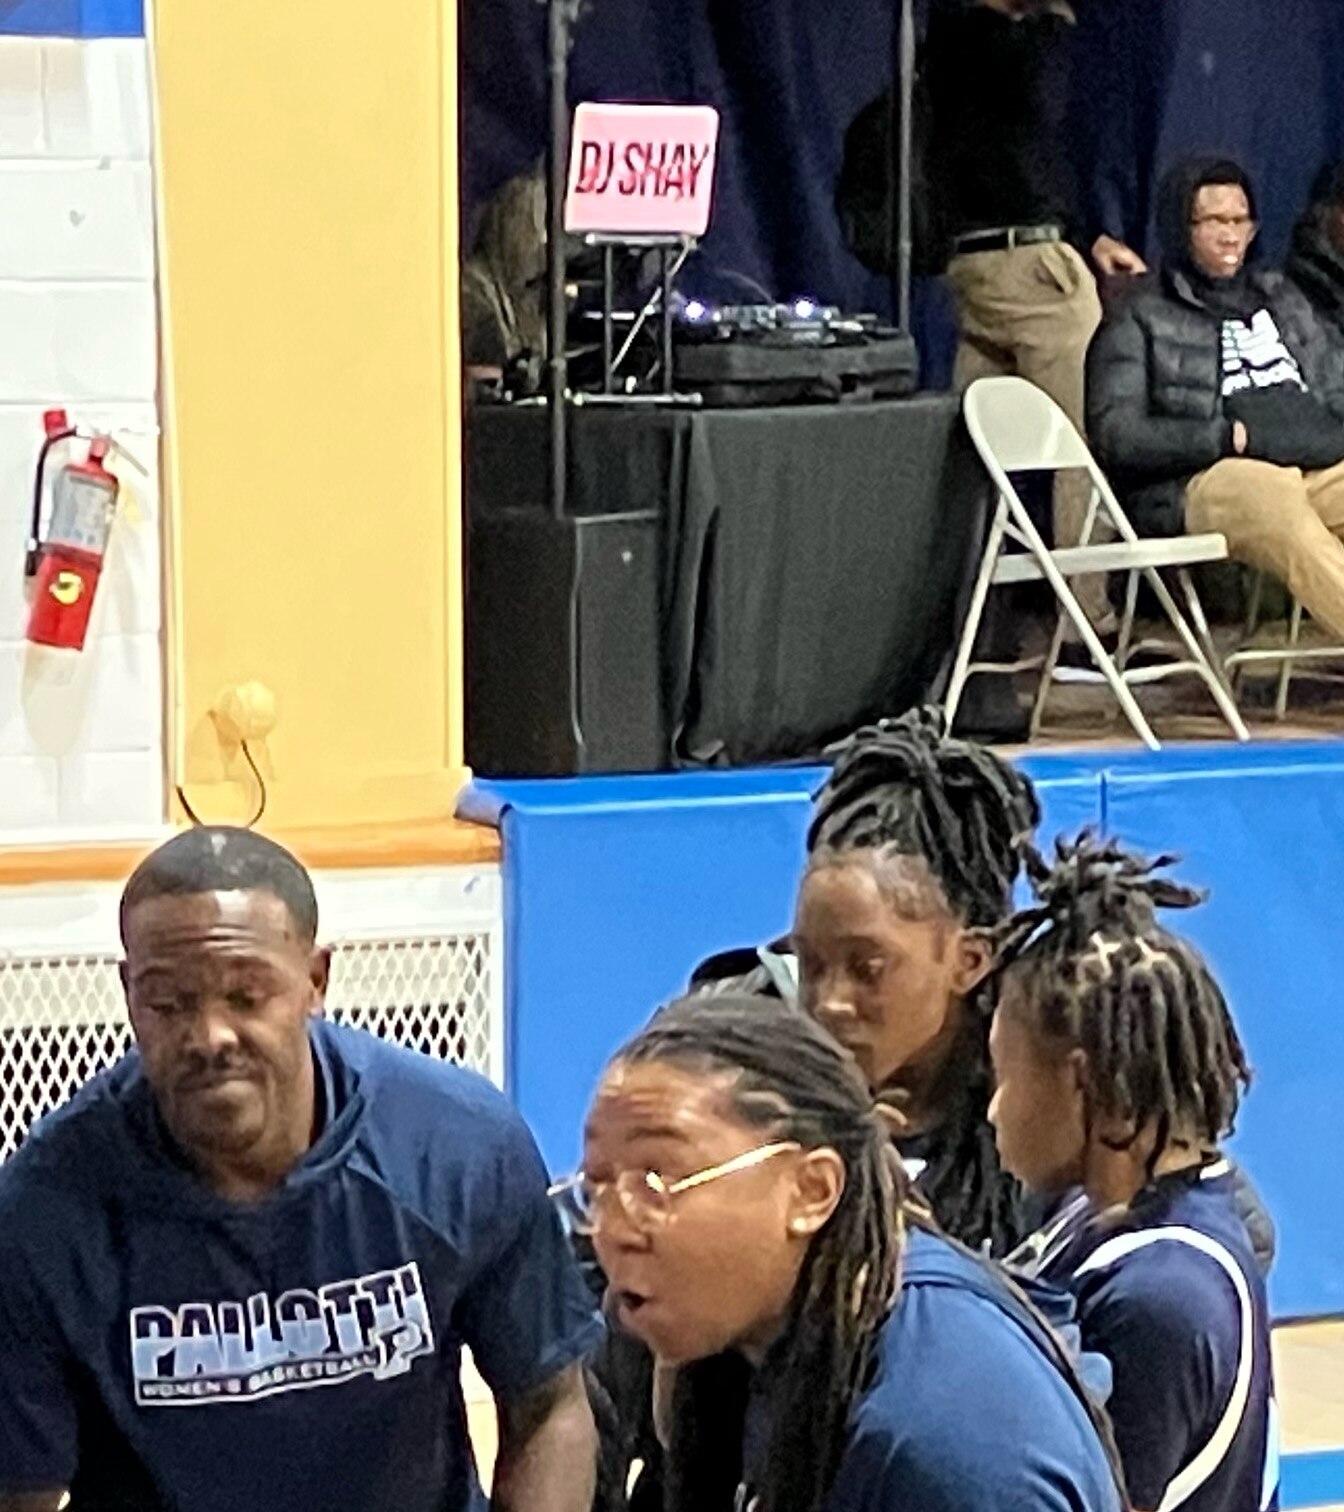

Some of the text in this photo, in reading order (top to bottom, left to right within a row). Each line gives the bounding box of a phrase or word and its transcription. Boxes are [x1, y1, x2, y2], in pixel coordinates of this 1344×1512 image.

[575, 140, 710, 199] DJ SHAY
[130, 1261, 430, 1378] PALLOTTI
[249, 1352, 378, 1392] BASKETBALL
